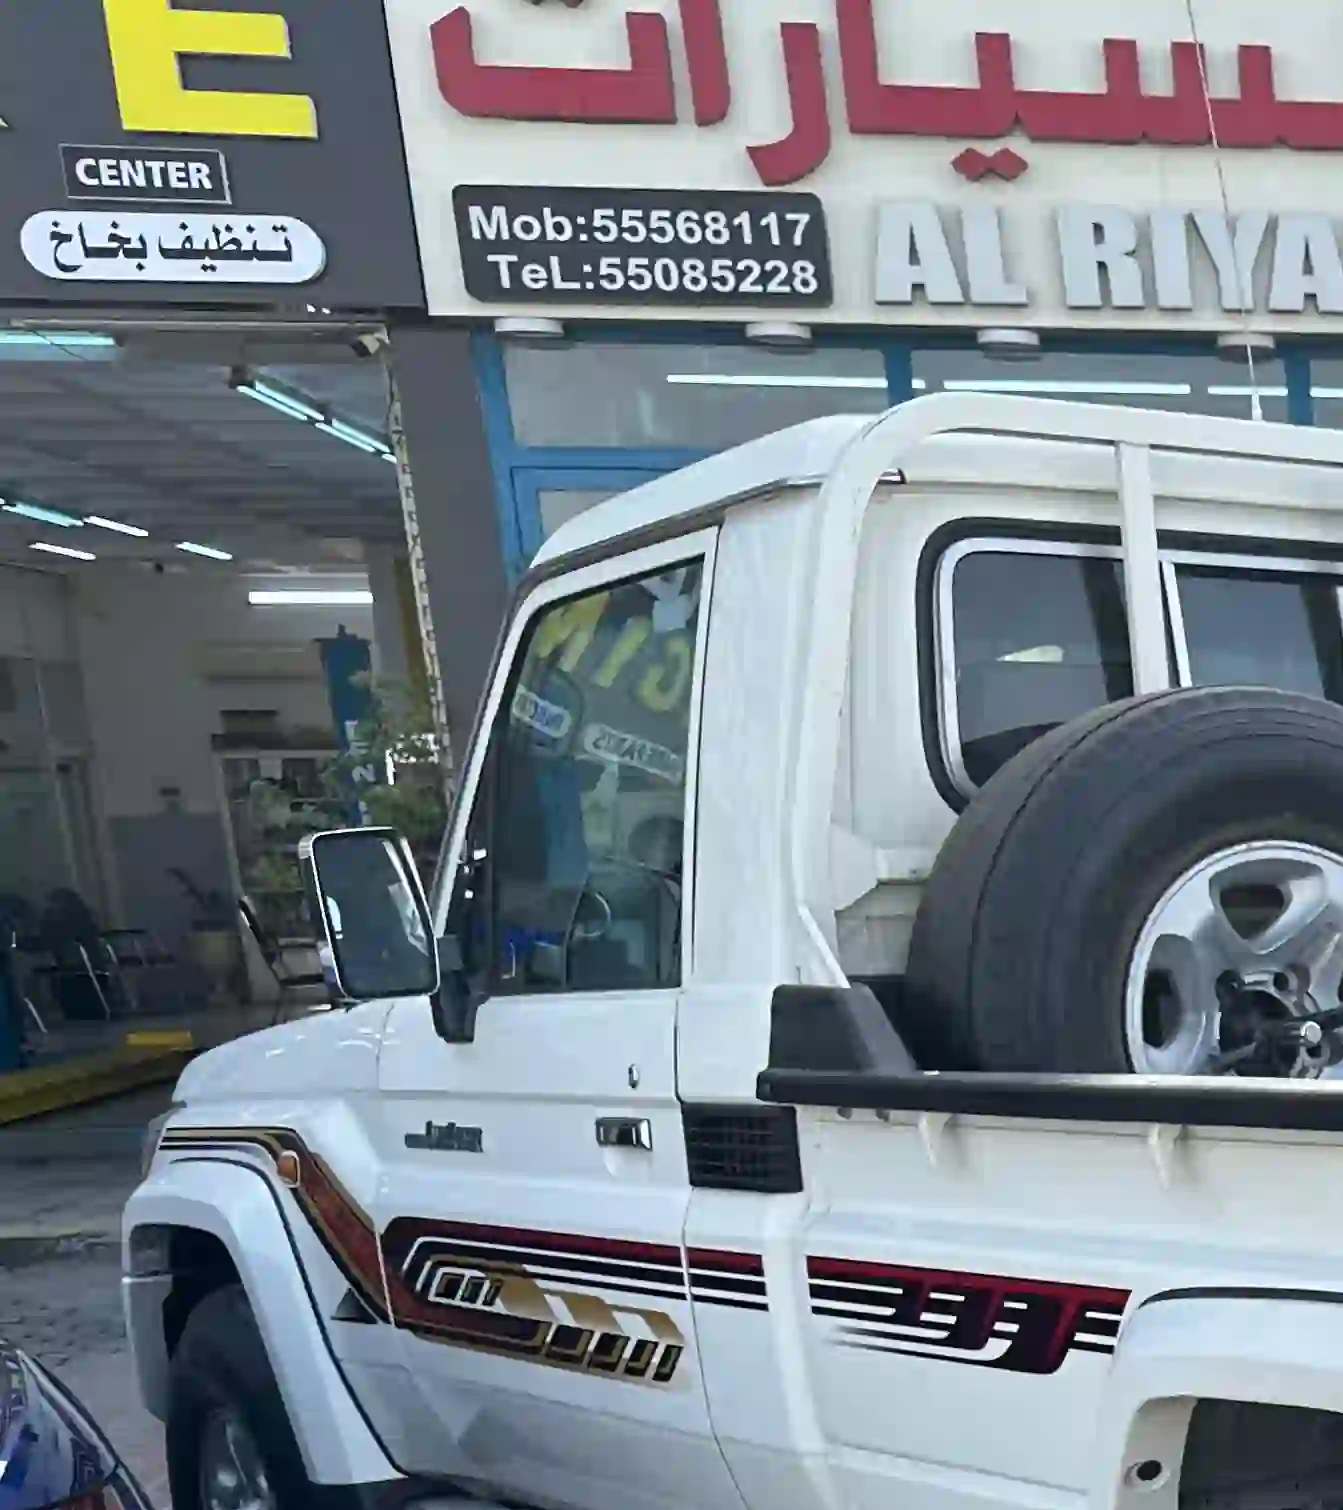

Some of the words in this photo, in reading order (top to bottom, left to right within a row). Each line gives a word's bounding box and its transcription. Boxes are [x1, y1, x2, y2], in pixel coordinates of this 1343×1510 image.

[75, 158, 213, 190] CENTER
[50, 220, 148, 273] بخاخ
[158, 222, 294, 272] تنظيف
[468, 205, 811, 247] Mob:55568117
[874, 203, 1028, 306] AL
